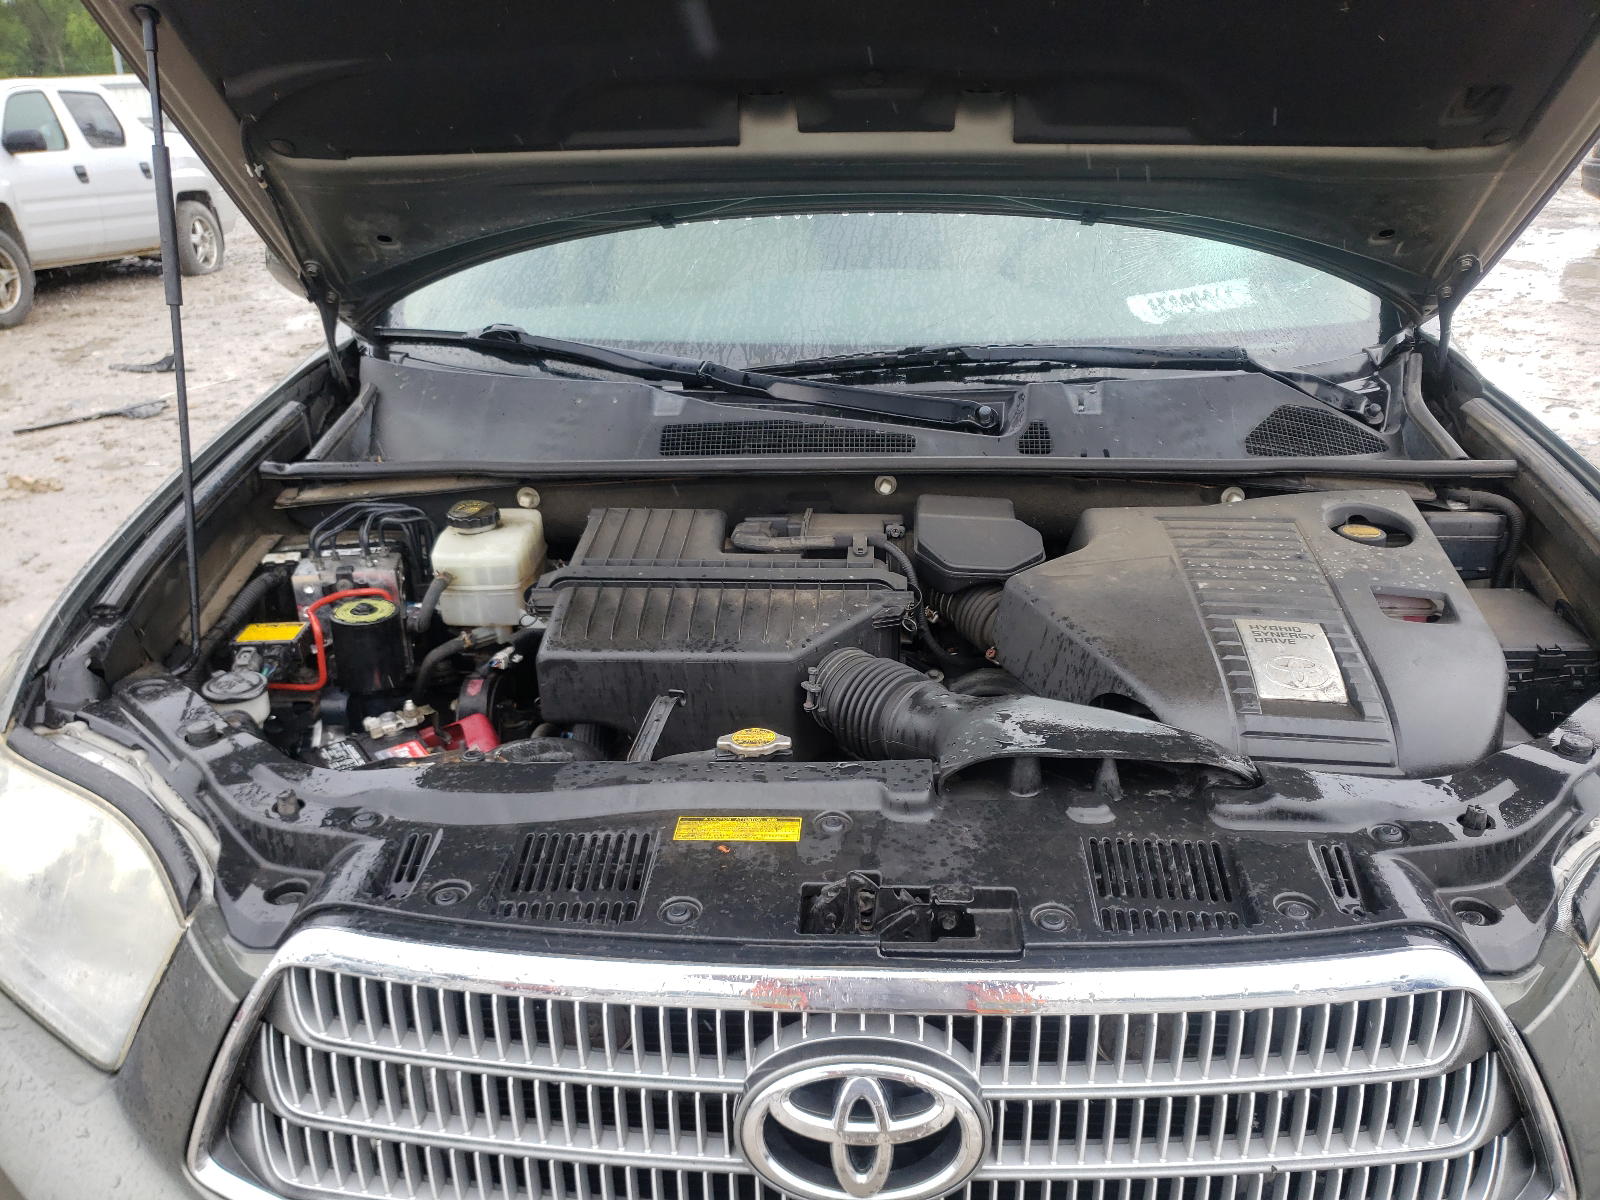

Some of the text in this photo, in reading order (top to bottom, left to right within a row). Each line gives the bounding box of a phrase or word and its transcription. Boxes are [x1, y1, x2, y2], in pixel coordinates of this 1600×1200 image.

[1248, 624, 1302, 633] HYBRID
[1251, 630, 1317, 640] SYNERGY
[1254, 637, 1296, 645] DRIVE
